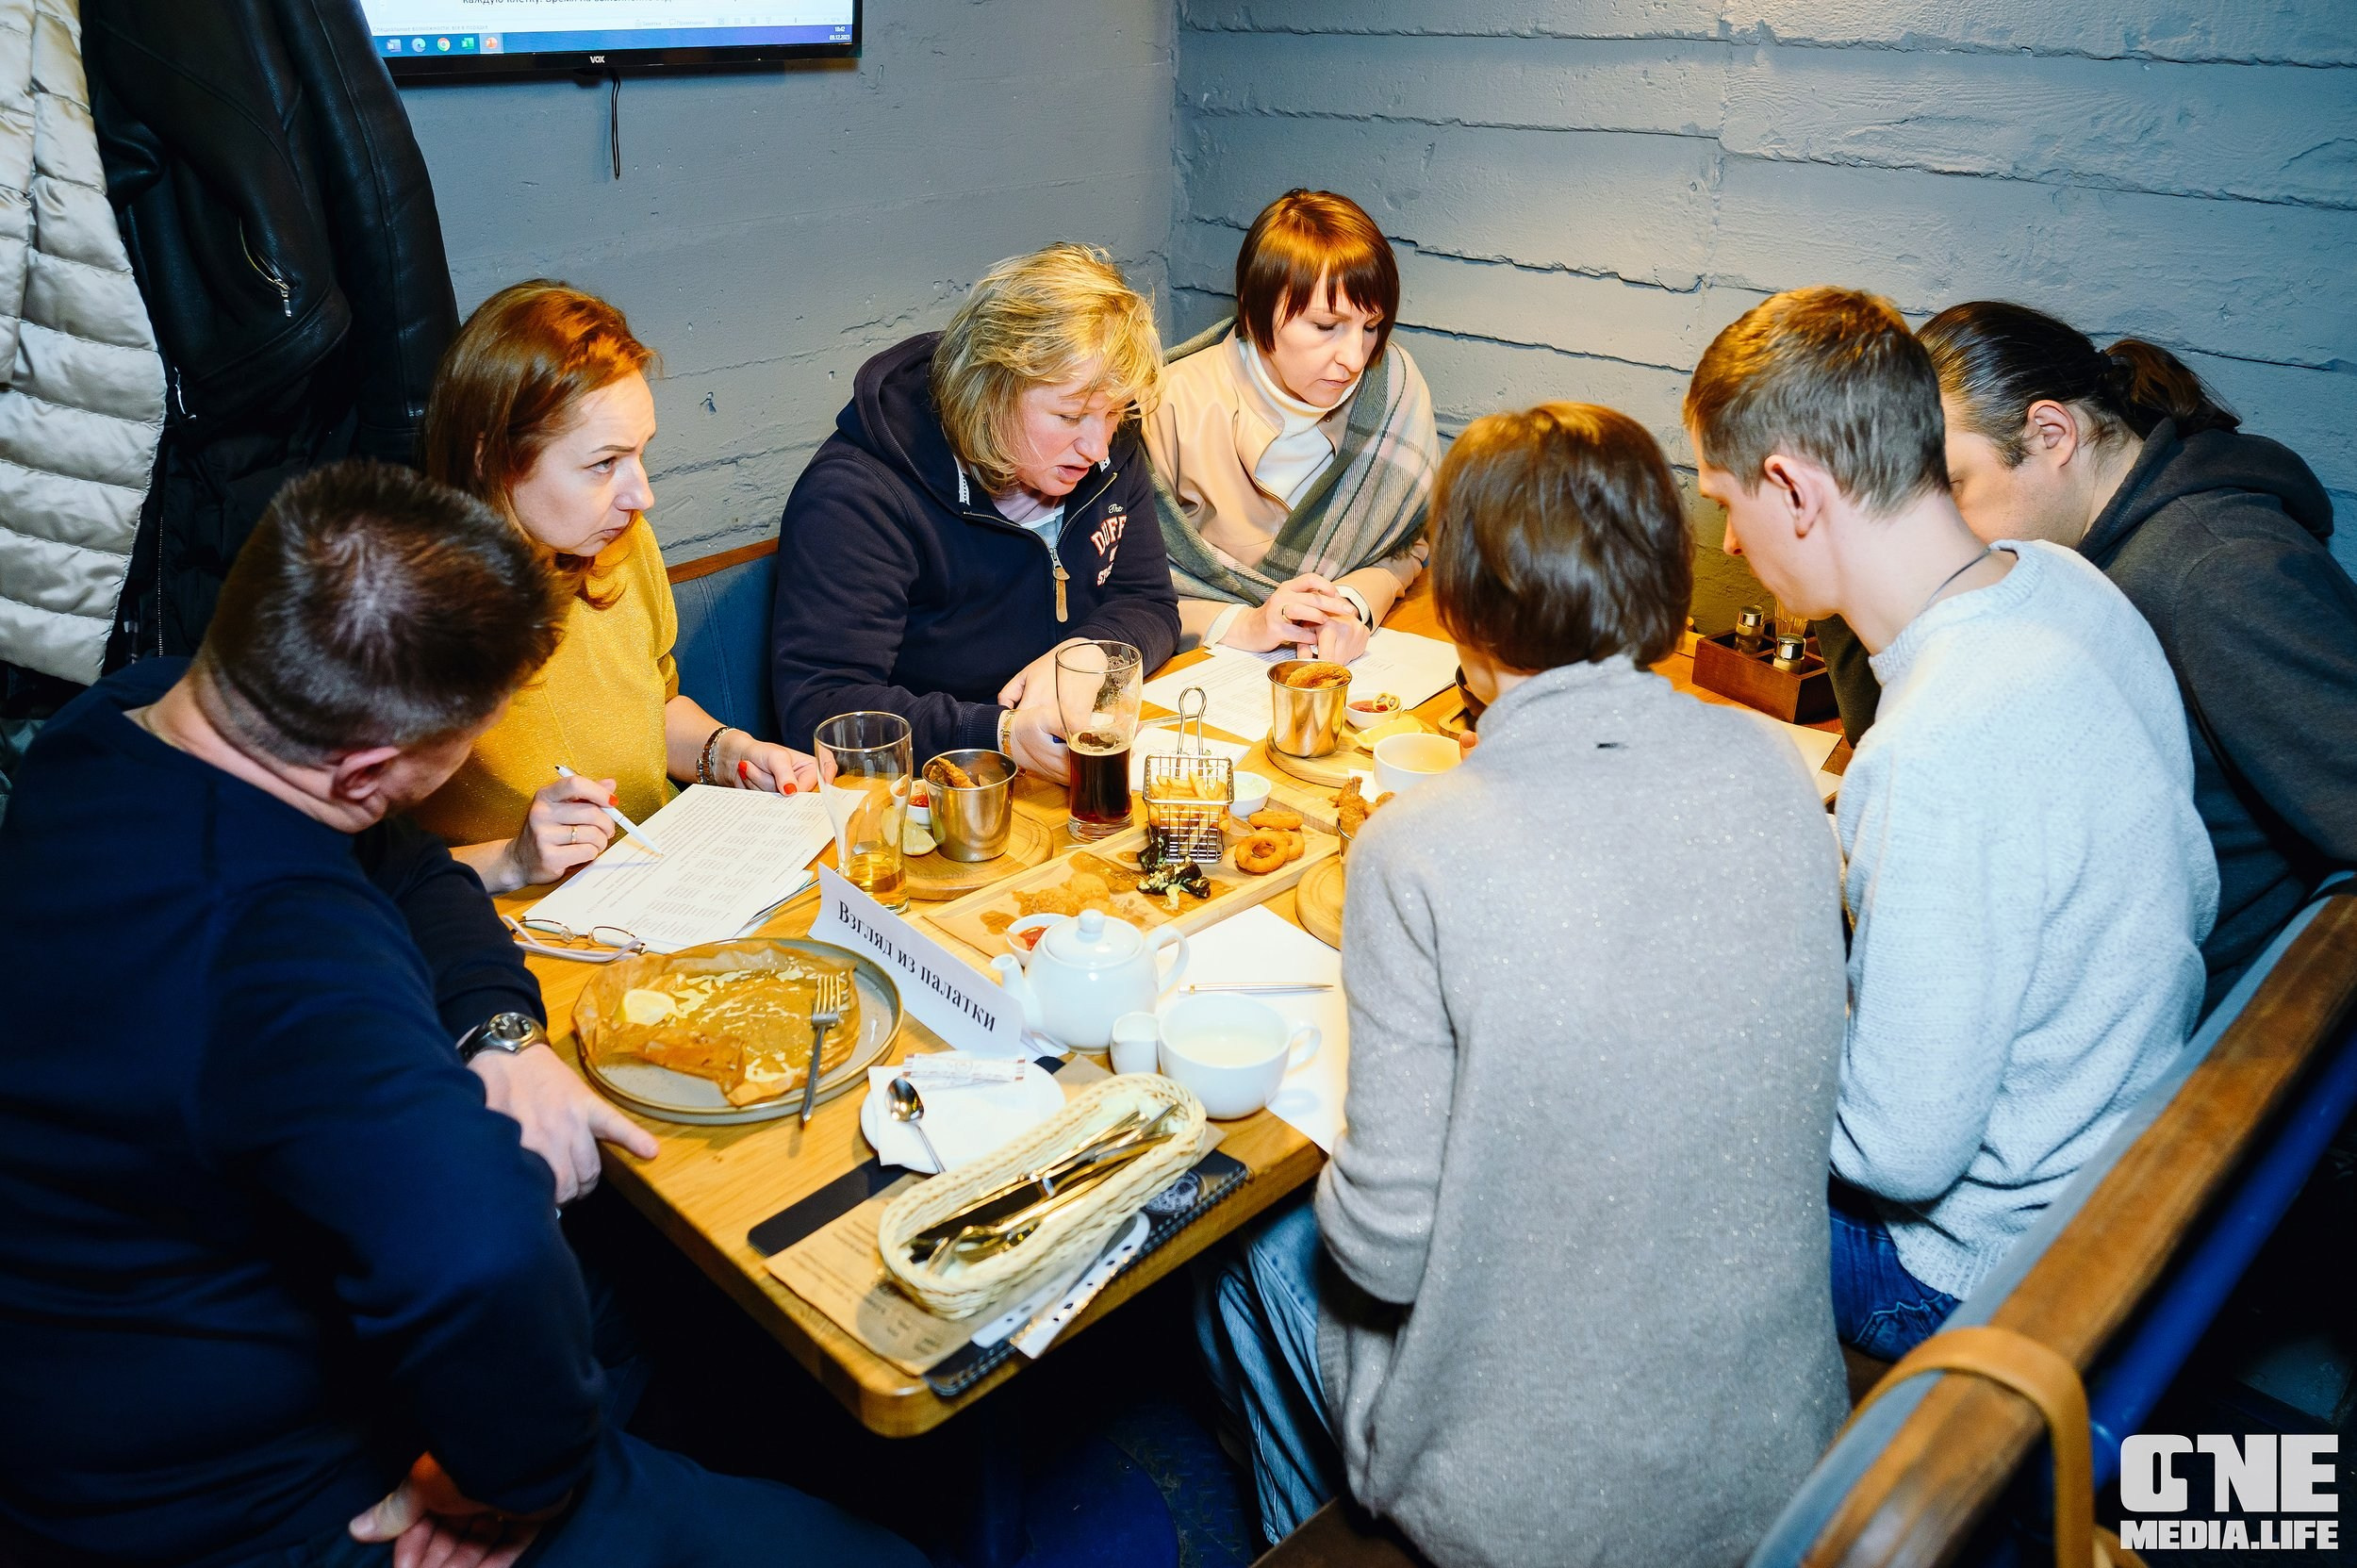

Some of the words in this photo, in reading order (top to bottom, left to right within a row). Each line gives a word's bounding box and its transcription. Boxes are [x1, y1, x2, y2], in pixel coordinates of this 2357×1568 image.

[838, 900, 893, 960] Взгляд
[898, 949, 915, 974] из
[920, 966, 997, 1032] палатки
